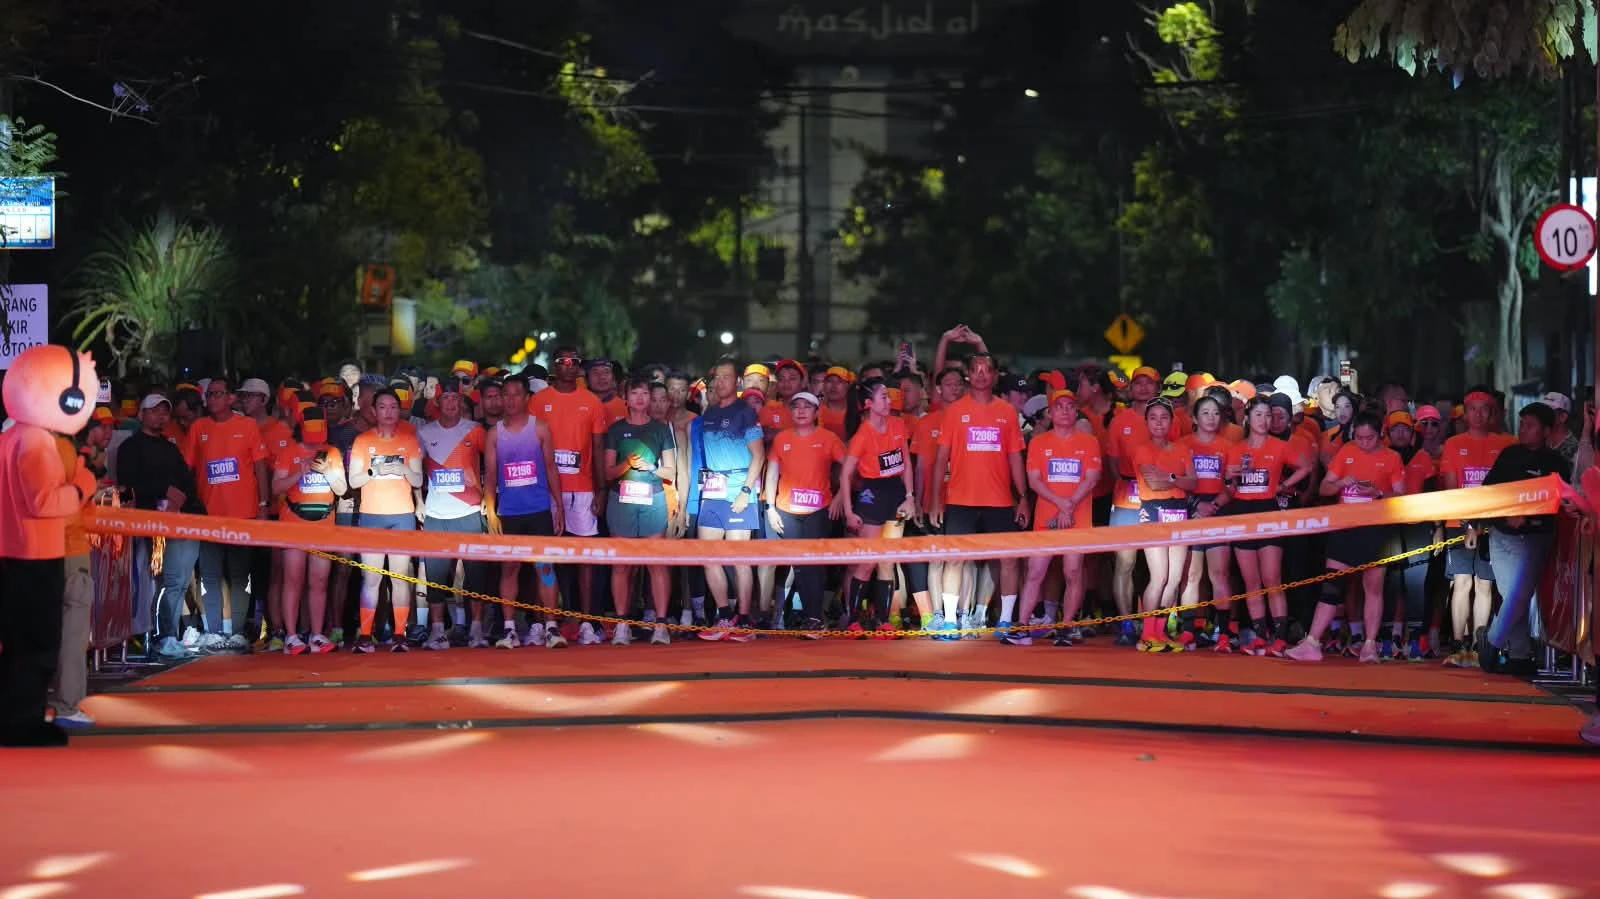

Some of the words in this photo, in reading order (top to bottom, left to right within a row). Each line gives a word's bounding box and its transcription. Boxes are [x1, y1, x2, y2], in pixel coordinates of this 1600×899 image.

[1552, 227, 1577, 257] 10
[0, 297, 37, 312] RANG
[1052, 461, 1078, 473] T3030
[1464, 470, 1488, 481] T208
[793, 491, 819, 505] T2070
[1519, 489, 1549, 504] run
